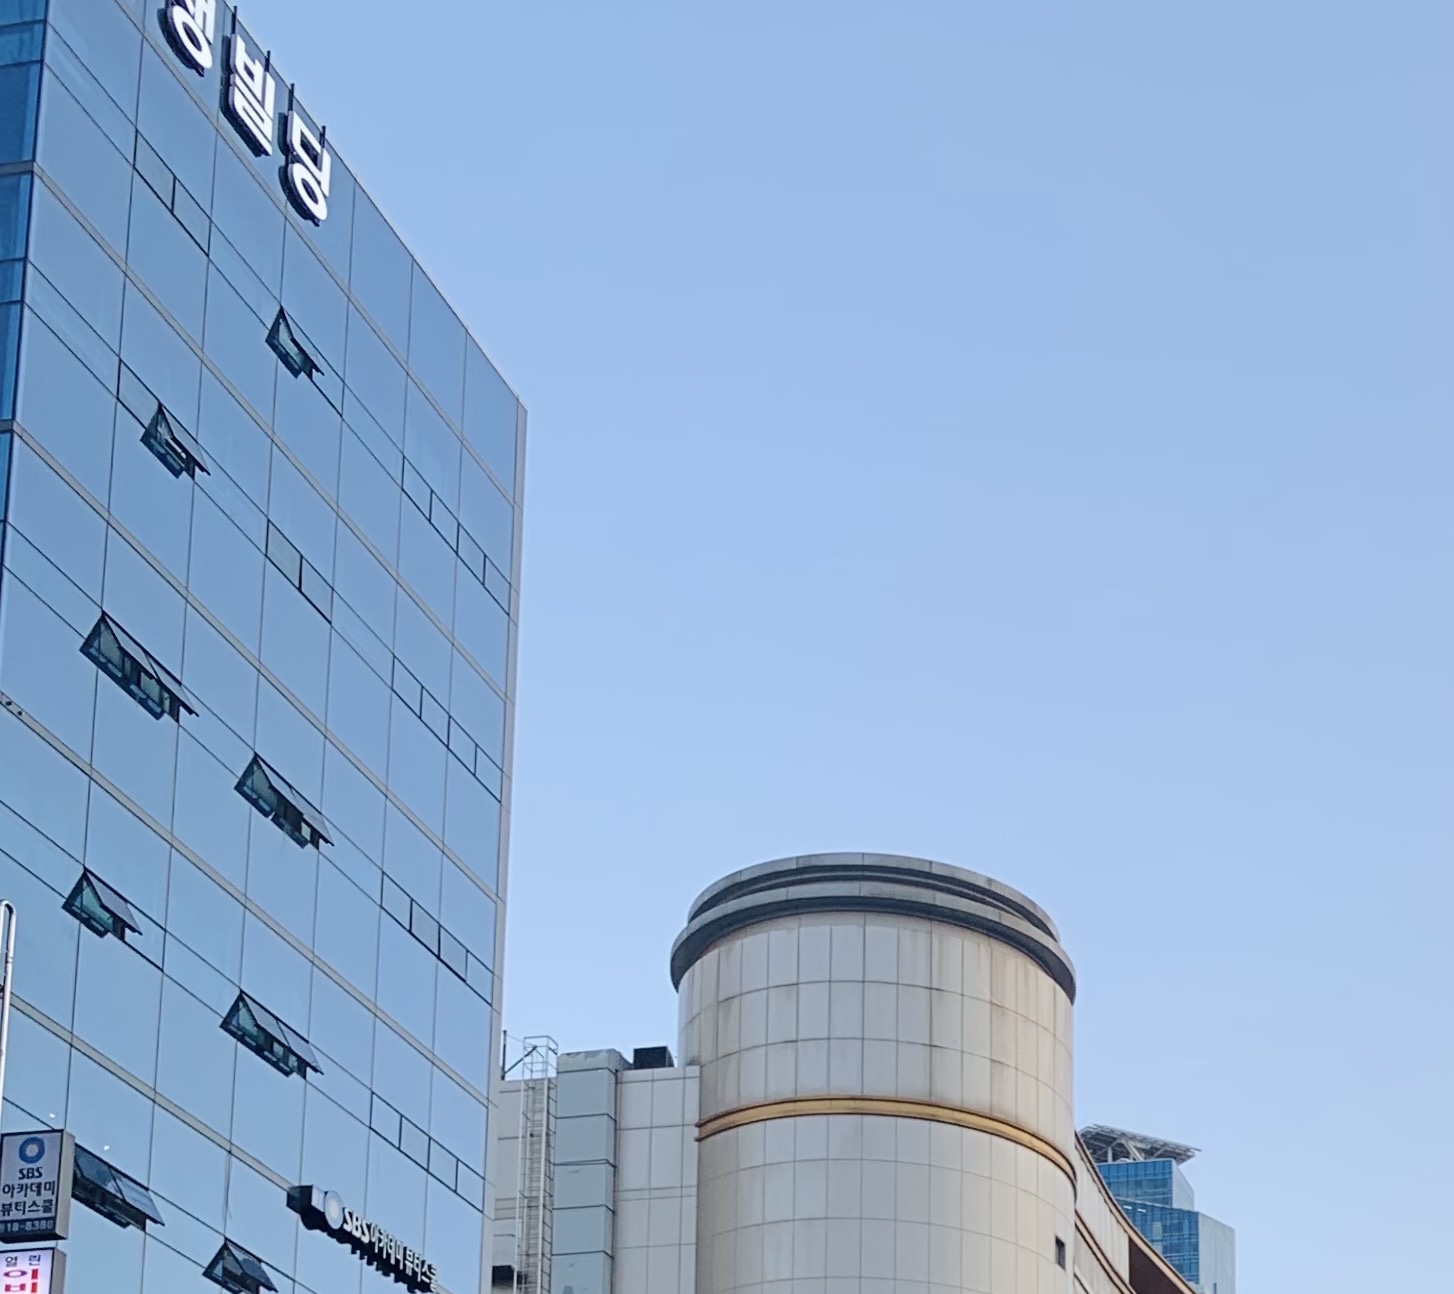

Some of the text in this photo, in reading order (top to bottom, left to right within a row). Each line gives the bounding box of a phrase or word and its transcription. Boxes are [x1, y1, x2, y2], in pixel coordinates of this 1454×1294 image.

[18, 1167, 43, 1180] SBS
[2, 1181, 55, 1198] 아카데미
[0, 1199, 54, 1216] 뷰티스쿨
